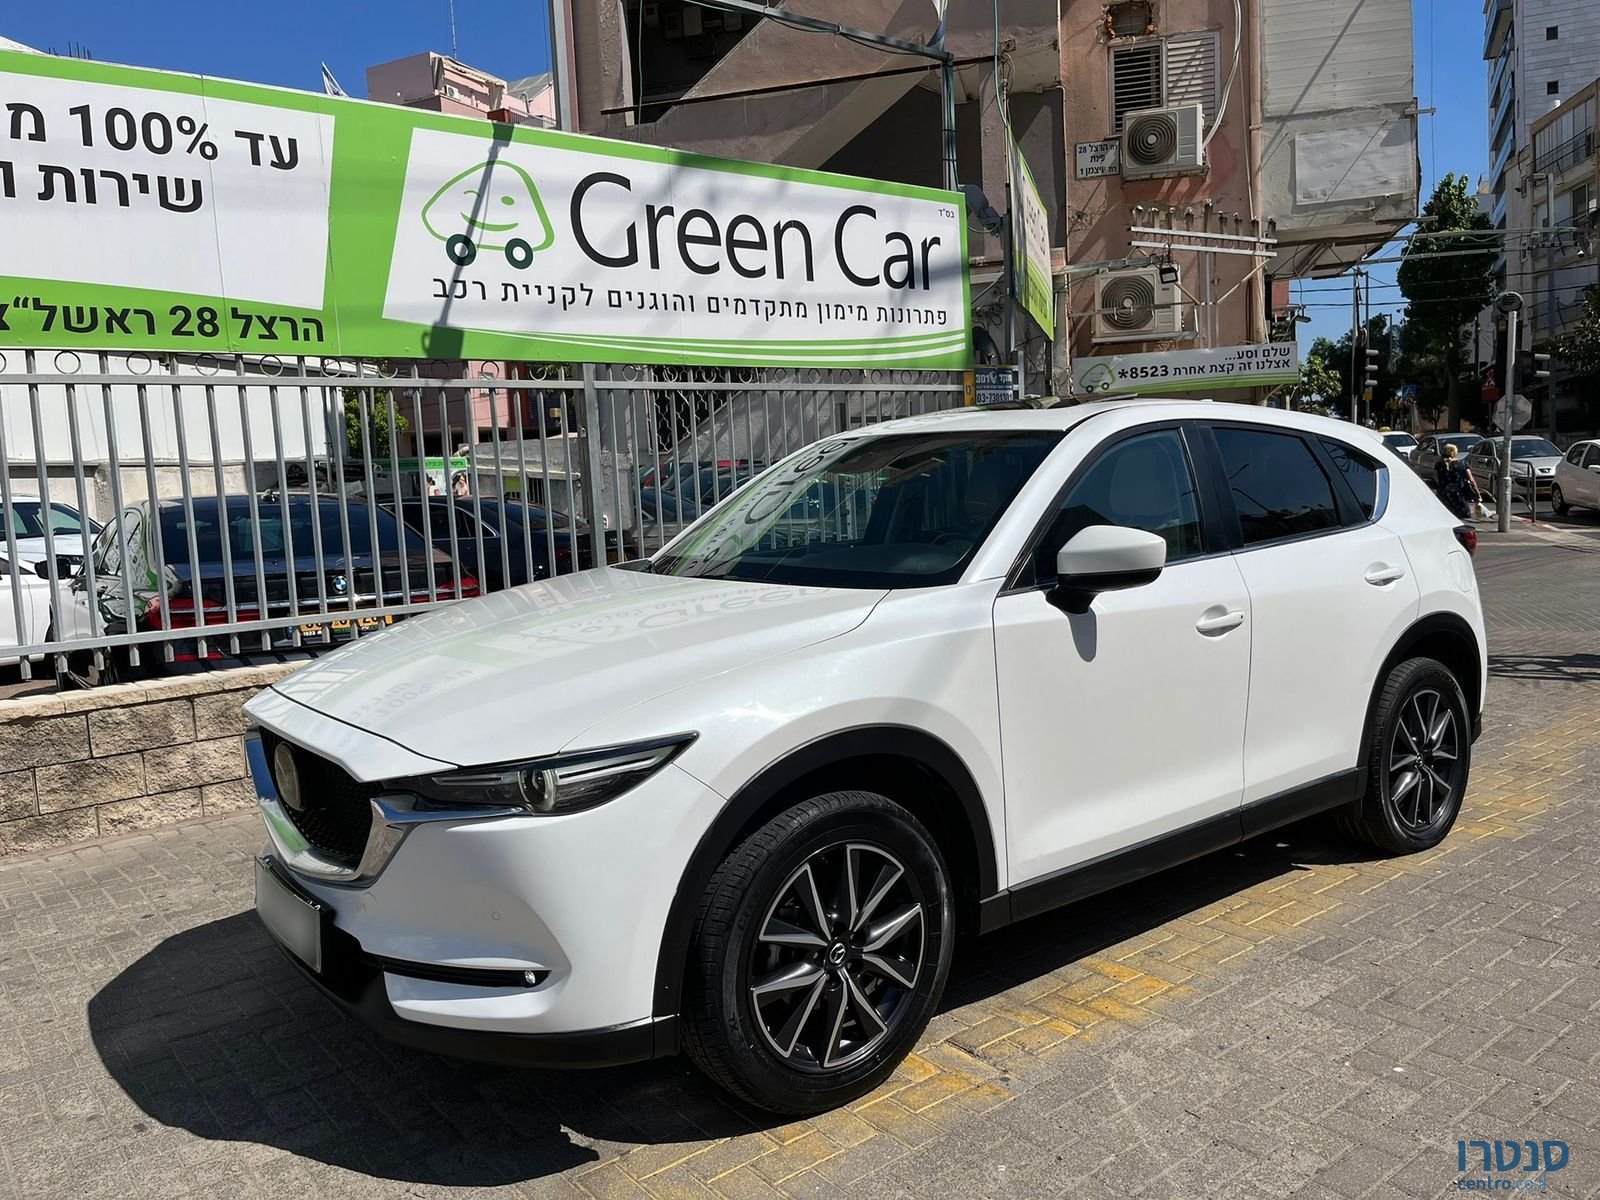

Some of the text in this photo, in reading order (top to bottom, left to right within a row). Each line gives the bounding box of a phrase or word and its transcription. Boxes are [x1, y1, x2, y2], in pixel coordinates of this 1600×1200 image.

[69, 104, 218, 161] 100%
[235, 131, 299, 170] עד
[1078, 146, 1087, 154] 28
[38, 162, 204, 212] שירות
[571, 171, 815, 282] Green
[834, 204, 941, 291] Car
[433, 278, 948, 325] פתרונות מימון מתקדמים והוגנים לקניית רכב
[169, 305, 220, 338] 28
[231, 307, 324, 342] הרצל
[1209, 362, 1235, 375] קצת
[1225, 346, 1290, 360] שלם וסע...
[1239, 360, 1252, 371] זה
[1256, 358, 1291, 370] אצלנו
[1173, 364, 1205, 376] אחרת
